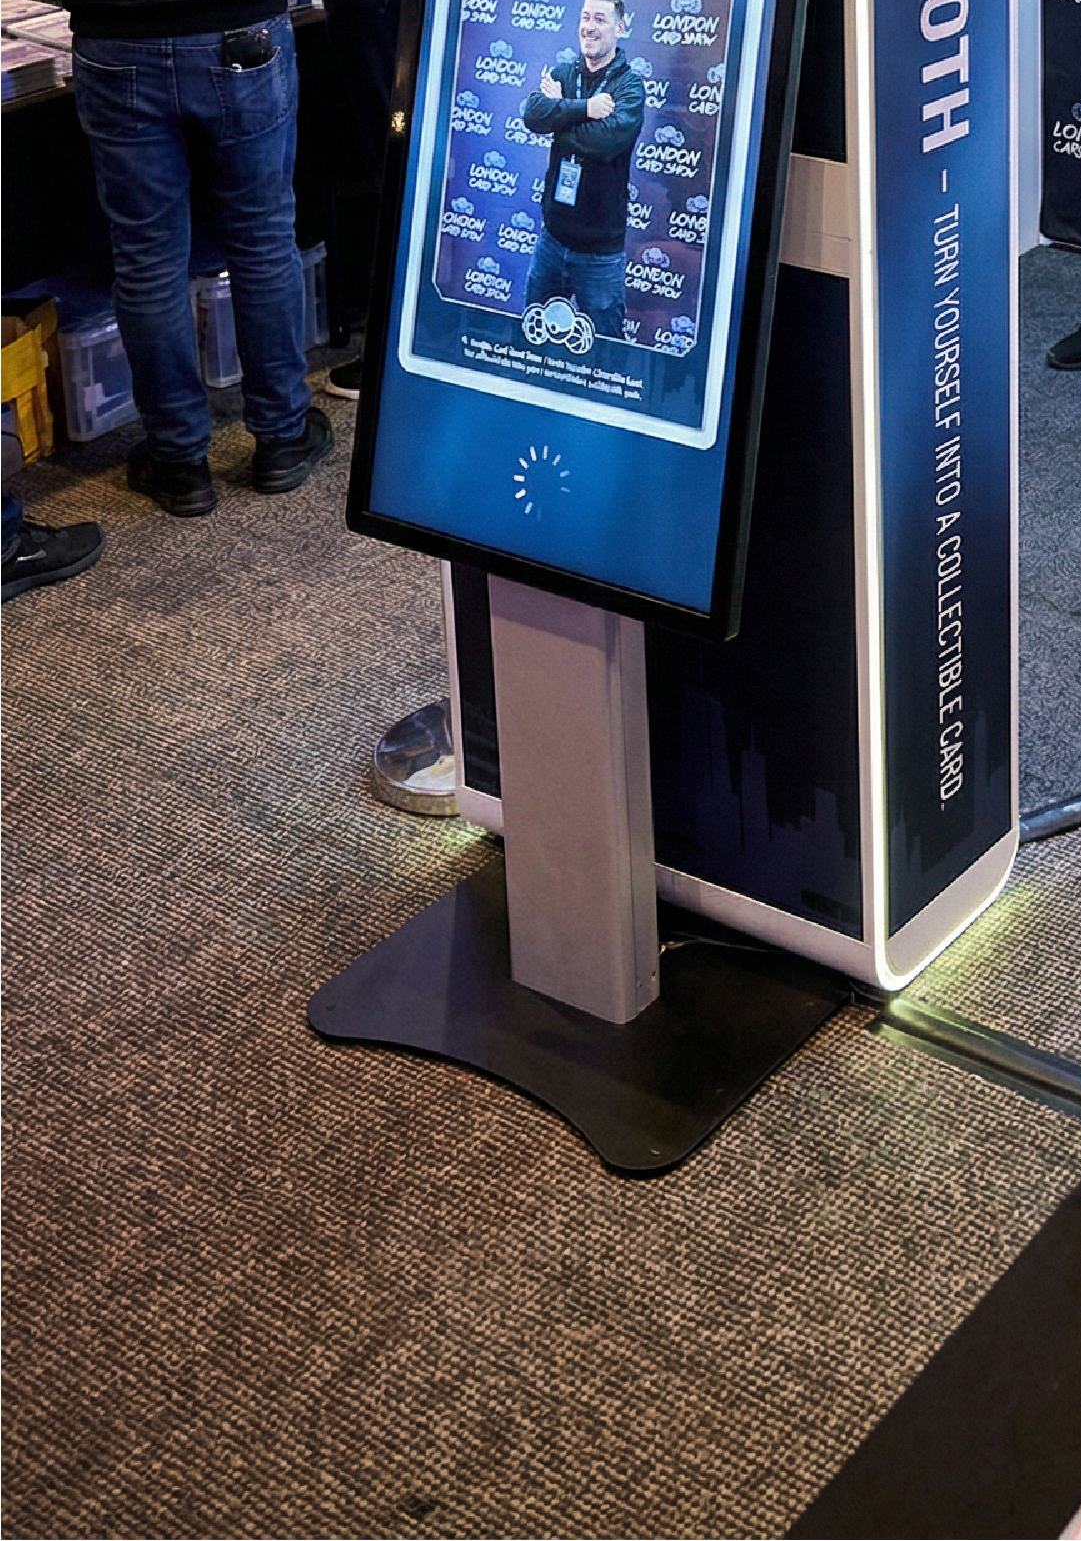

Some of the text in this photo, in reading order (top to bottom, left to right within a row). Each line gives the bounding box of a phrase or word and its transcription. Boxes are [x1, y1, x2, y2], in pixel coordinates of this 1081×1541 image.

[934, 204, 959, 286] TURN
[934, 287, 960, 429] YOURSELF
[935, 436, 961, 506] INTO
[935, 511, 961, 535] A
[937, 536, 963, 725] COLLECTIBLE
[939, 721, 963, 811] CARD.
